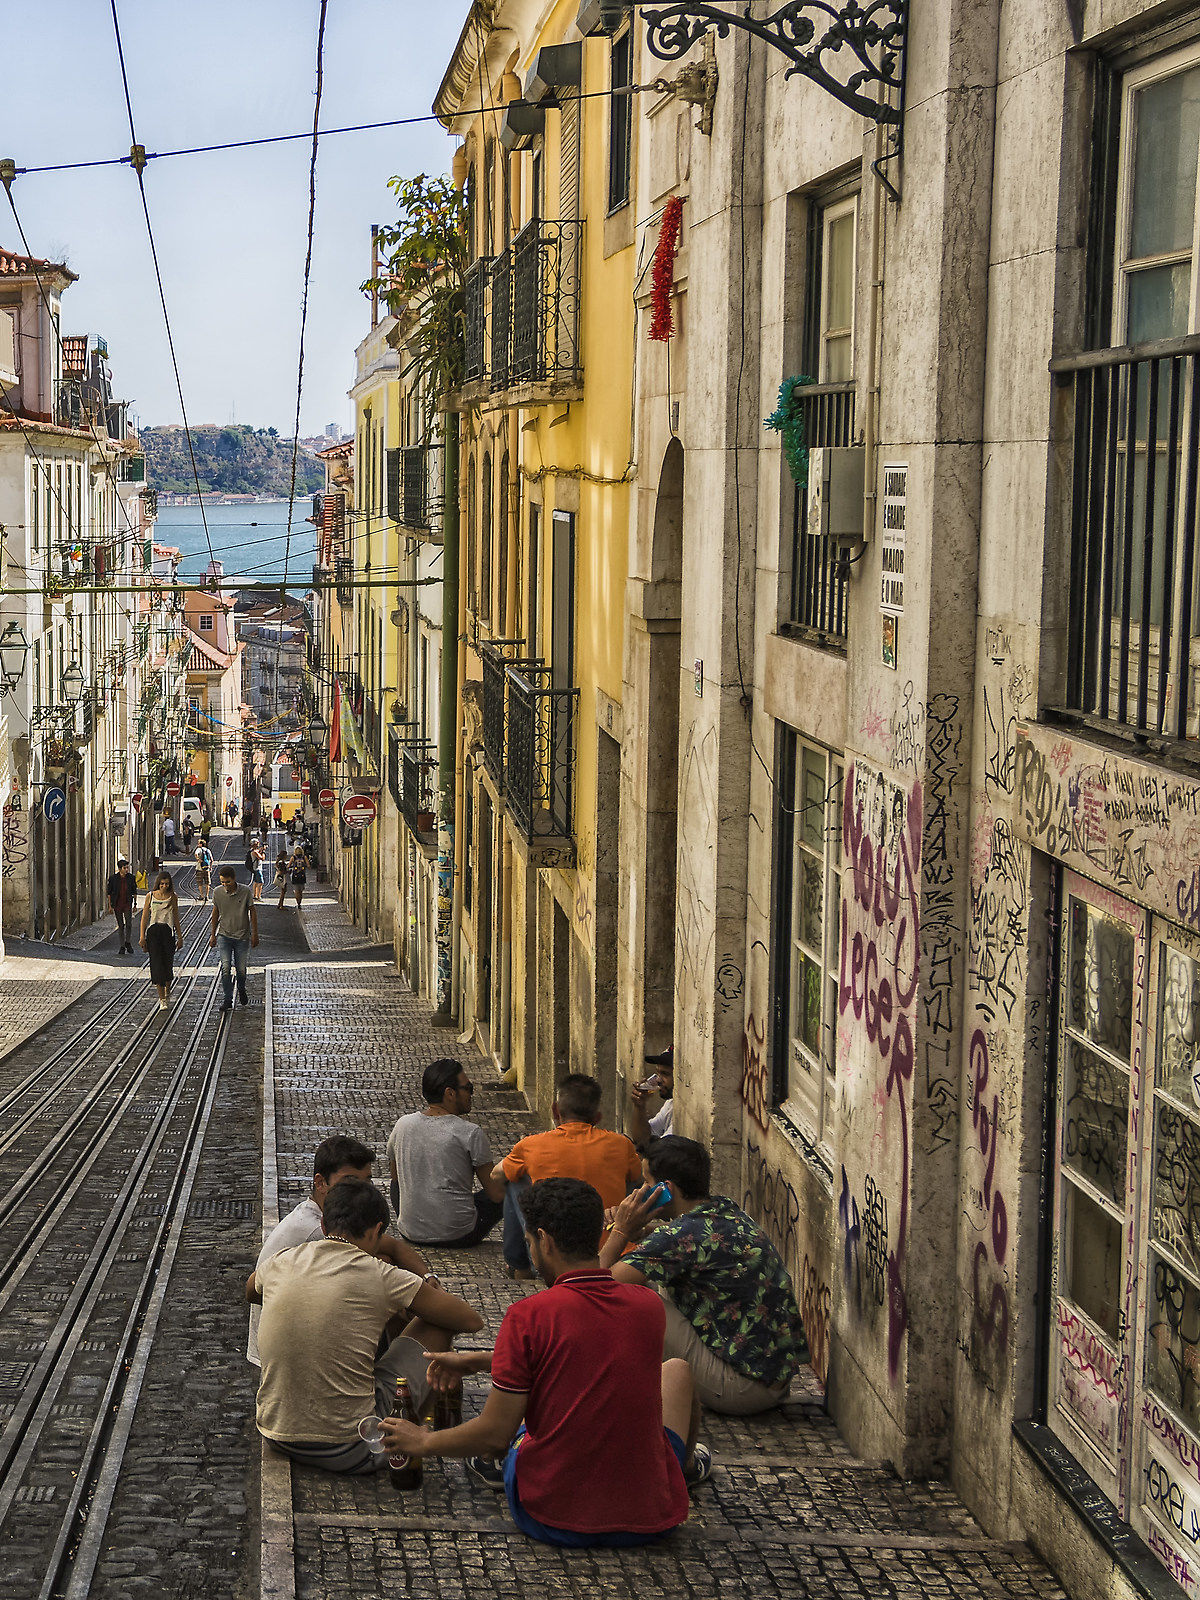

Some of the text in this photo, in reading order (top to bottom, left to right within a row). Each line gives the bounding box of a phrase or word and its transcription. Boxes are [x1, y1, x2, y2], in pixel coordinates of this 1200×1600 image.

[882, 547, 904, 574] MAIOR
[881, 574, 904, 606] É O MAR
